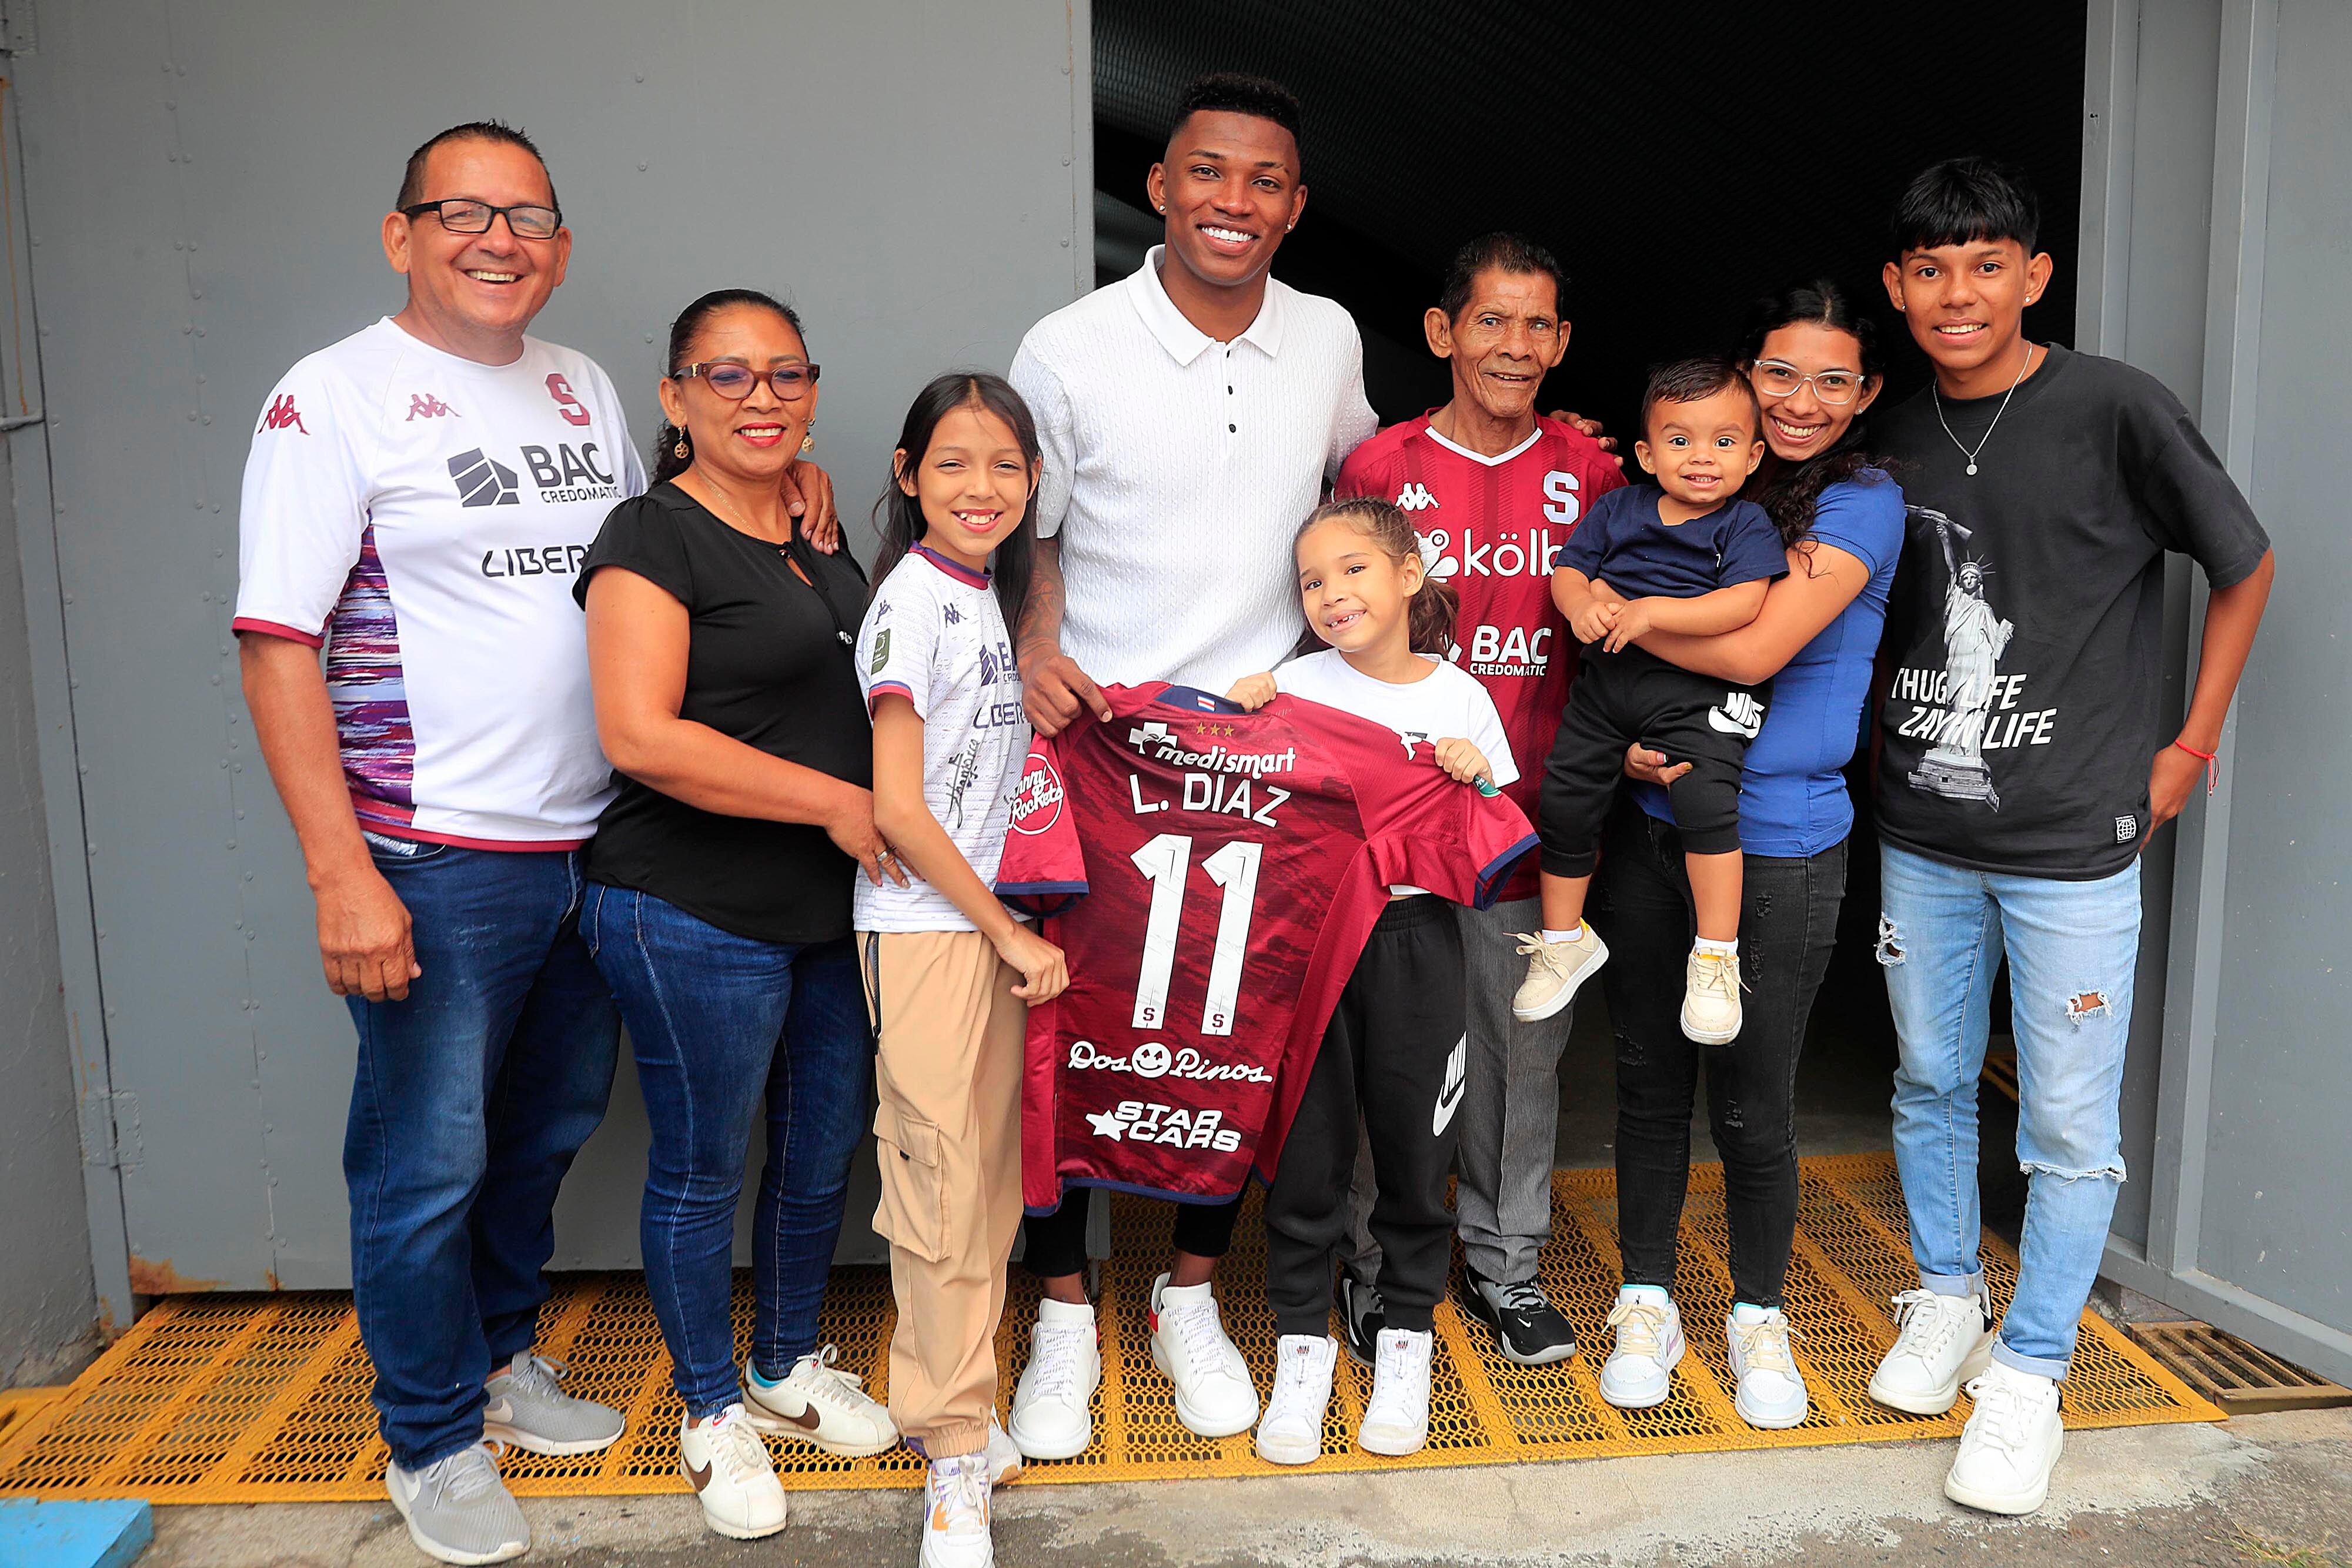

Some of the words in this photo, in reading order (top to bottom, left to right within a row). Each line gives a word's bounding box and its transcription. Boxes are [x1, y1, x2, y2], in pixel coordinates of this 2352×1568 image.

[520, 442, 615, 488] BAC
[1542, 470, 1580, 525] S
[482, 544, 593, 577] LIBER
[1471, 624, 1552, 664] BAC
[1469, 663, 1546, 677] CREDOMATIC
[1890, 667, 1948, 705] THUG
[1959, 673, 2027, 711] LIFE
[1982, 708, 2057, 750] LIFE
[1155, 744, 1296, 780] medismart
[1129, 774, 1170, 814] L.
[1182, 773, 1291, 828] DIAZ
[1130, 833, 1264, 1037] 11
[1068, 1040, 1132, 1072] Dos
[1169, 1048, 1273, 1082] Pinos
[1114, 1101, 1222, 1130] STAR
[1128, 1121, 1241, 1152] CARS
